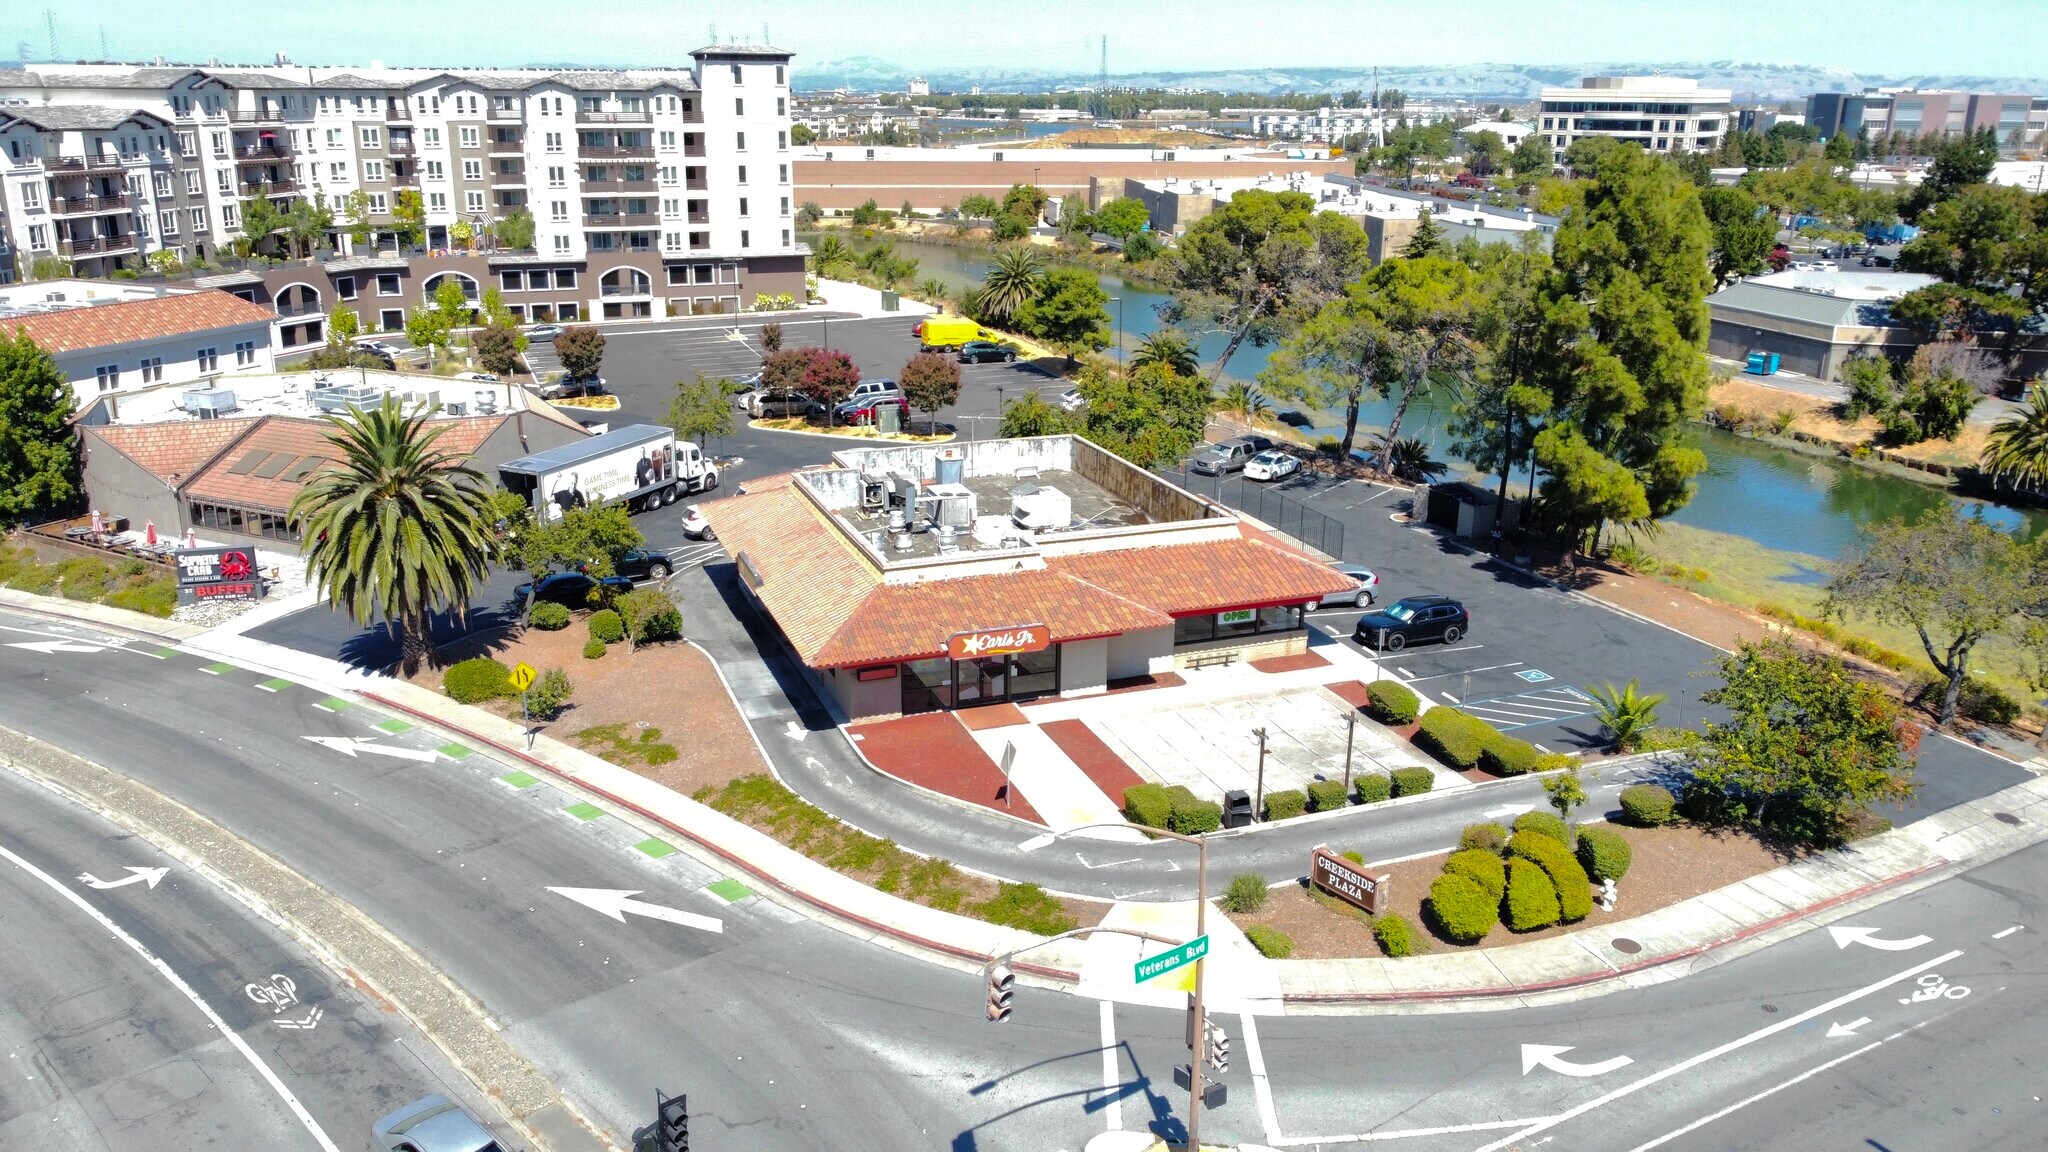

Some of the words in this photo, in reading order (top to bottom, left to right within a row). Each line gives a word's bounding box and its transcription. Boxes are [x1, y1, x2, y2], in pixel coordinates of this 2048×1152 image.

[187, 565, 212, 576] CRAB
[196, 584, 252, 596] BUFFET
[1224, 610, 1250, 622] OPEN
[978, 632, 1014, 650] Carl's
[1015, 630, 1036, 646] Jr.
[1318, 856, 1374, 893] CREEKSIDE
[1328, 874, 1362, 900] PLAZA
[1138, 954, 1180, 978] Veterans
